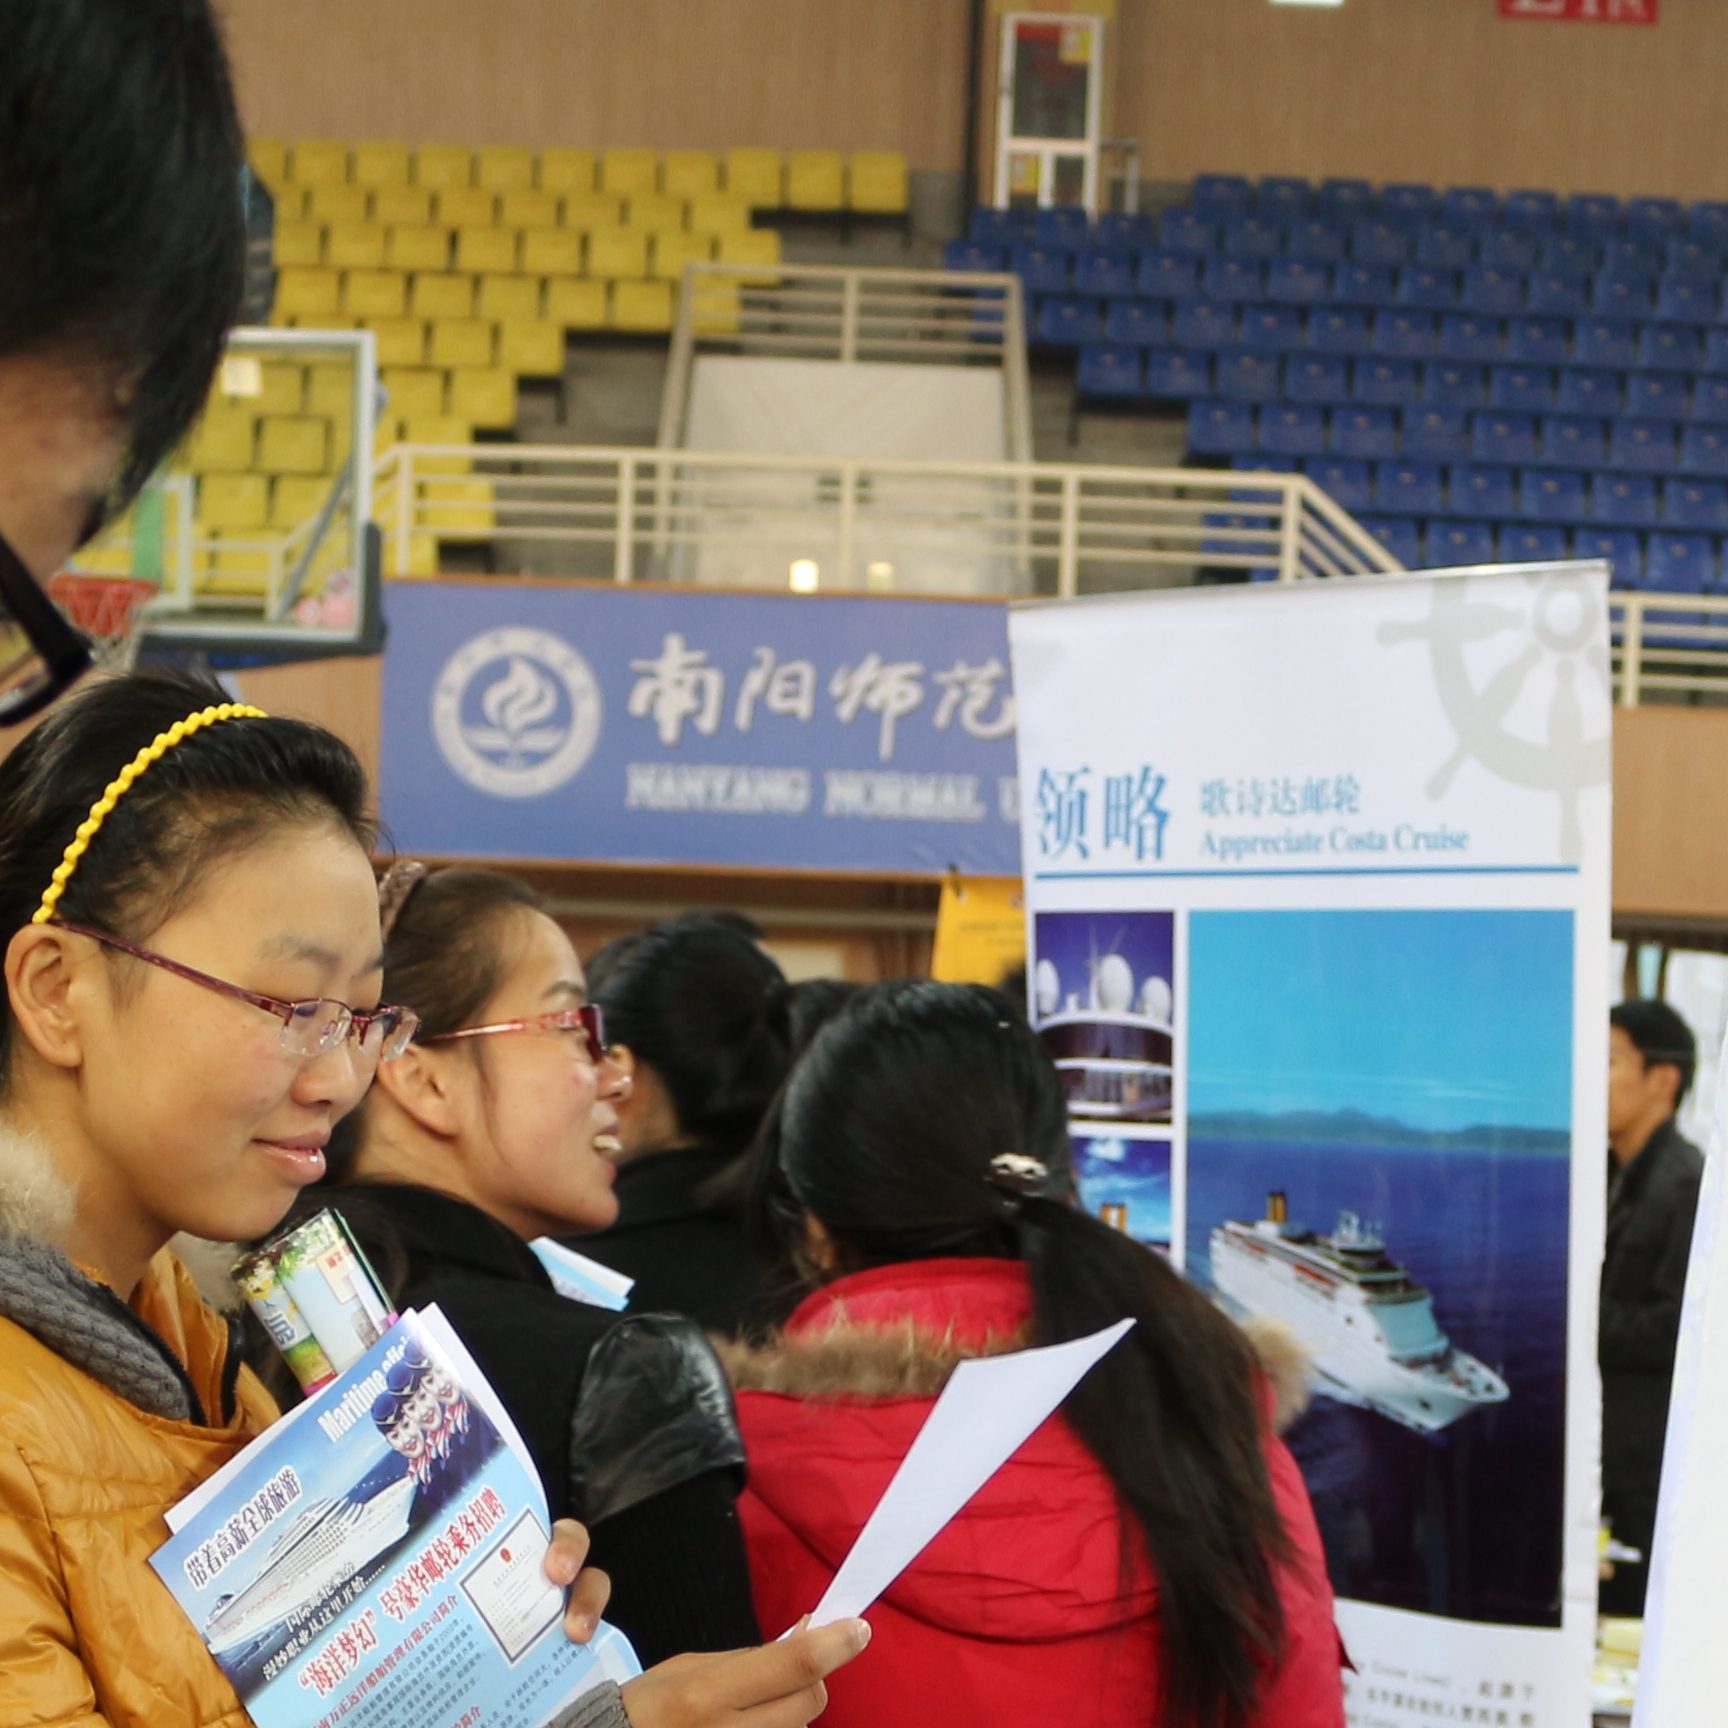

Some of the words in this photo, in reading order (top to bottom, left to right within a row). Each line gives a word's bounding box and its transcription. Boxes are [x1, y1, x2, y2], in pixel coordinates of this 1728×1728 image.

[626, 631, 1018, 761] 南阳师范
[1035, 763, 1170, 862] 领略
[1199, 773, 1361, 819] 歌诗达邮轮
[1199, 829, 1323, 861] Appreciate
[1329, 828, 1388, 853] Costa
[1393, 824, 1470, 852] Cruise
[317, 1369, 389, 1443] Maritime
[186, 1466, 302, 1589] 带着高薪全球旅游
